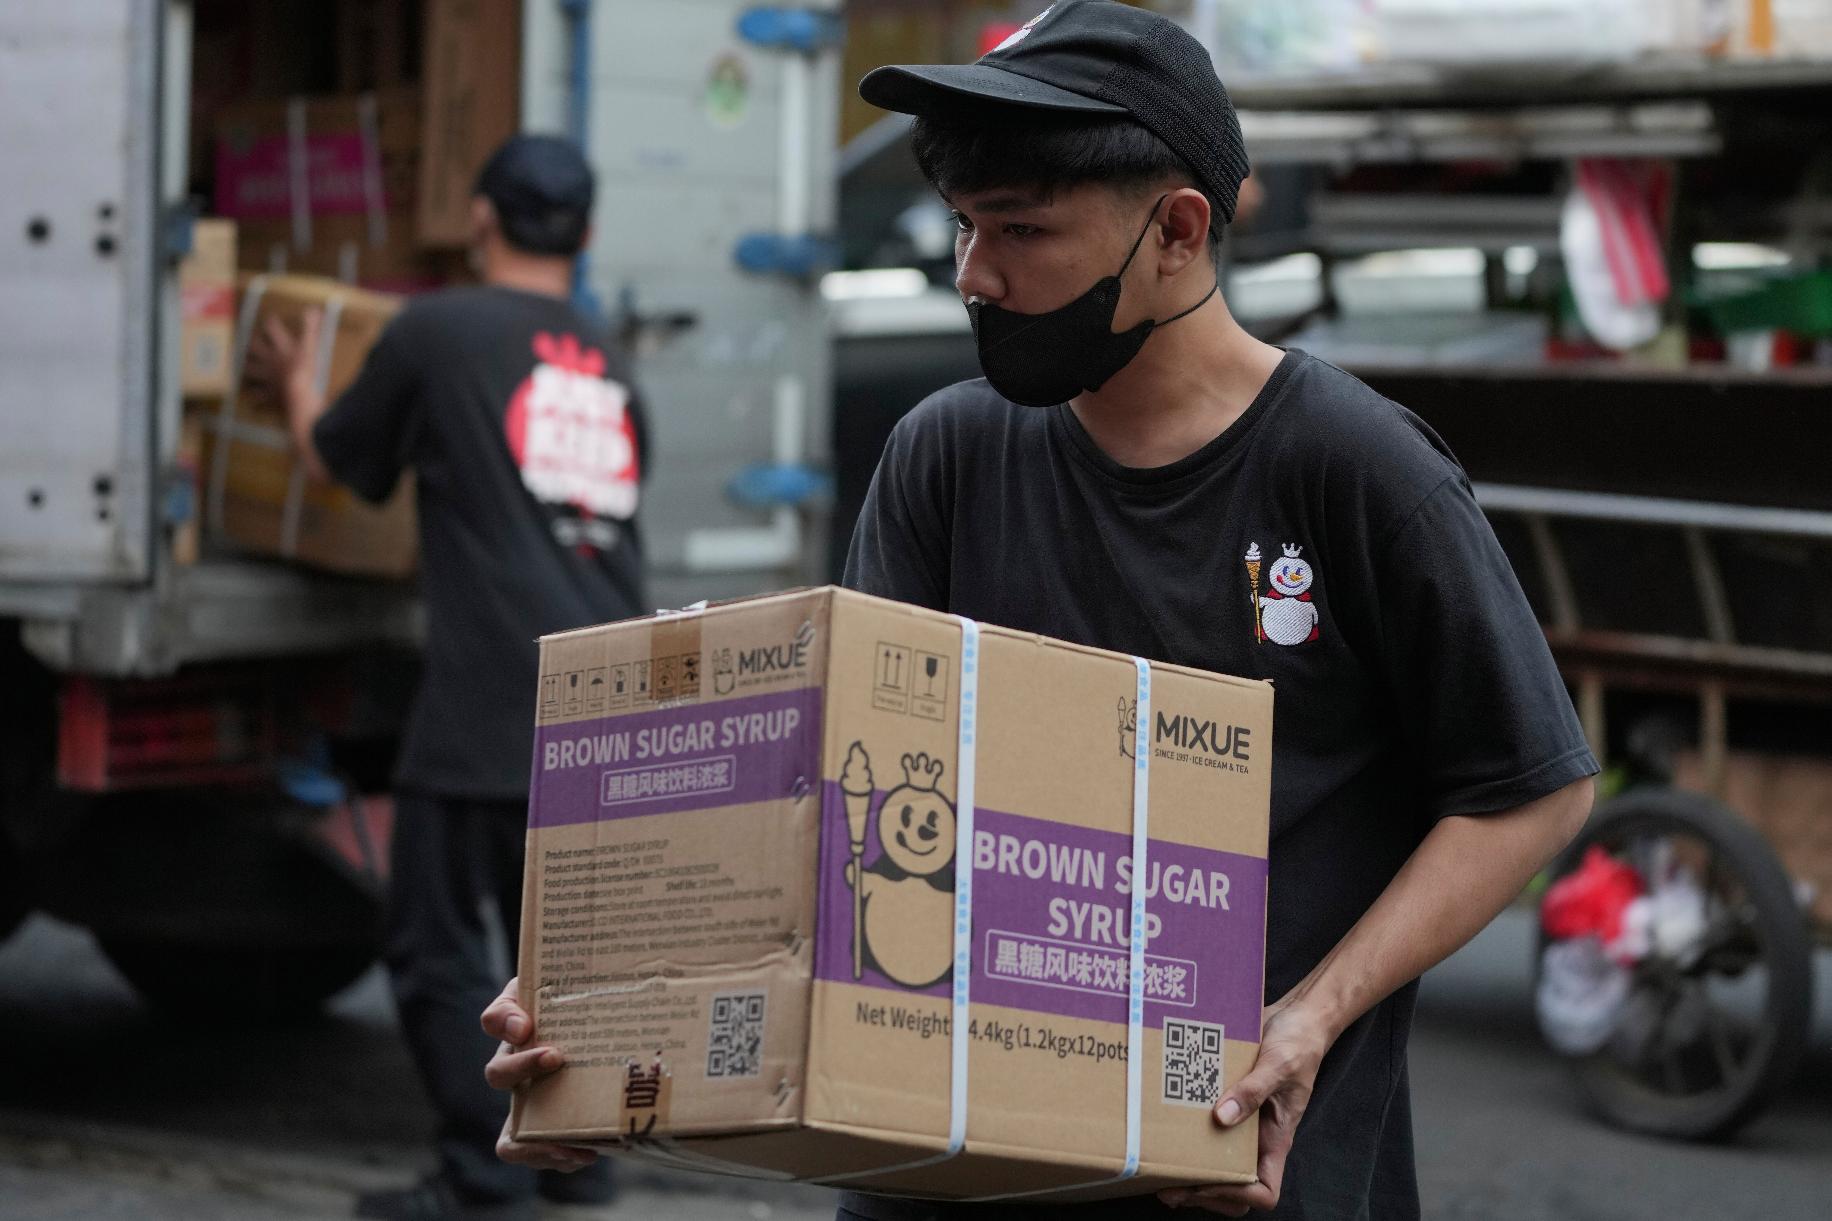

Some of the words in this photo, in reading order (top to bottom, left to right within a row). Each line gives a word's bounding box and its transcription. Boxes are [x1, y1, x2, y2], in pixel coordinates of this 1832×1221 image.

[739, 643, 806, 676] MIXUE
[544, 732, 630, 770] BROWN
[636, 721, 715, 760] SUGAR
[720, 708, 799, 748] SYRUP
[1154, 748, 1175, 760] SINCE
[1204, 758, 1228, 770] CREAM
[1236, 764, 1249, 774] TEA
[1156, 711, 1251, 761] MIXUE
[973, 830, 1105, 890] BROWN
[1114, 855, 1230, 911] SUGAR
[1047, 897, 1162, 950] SYRUP
[856, 1001, 886, 1027] Net
